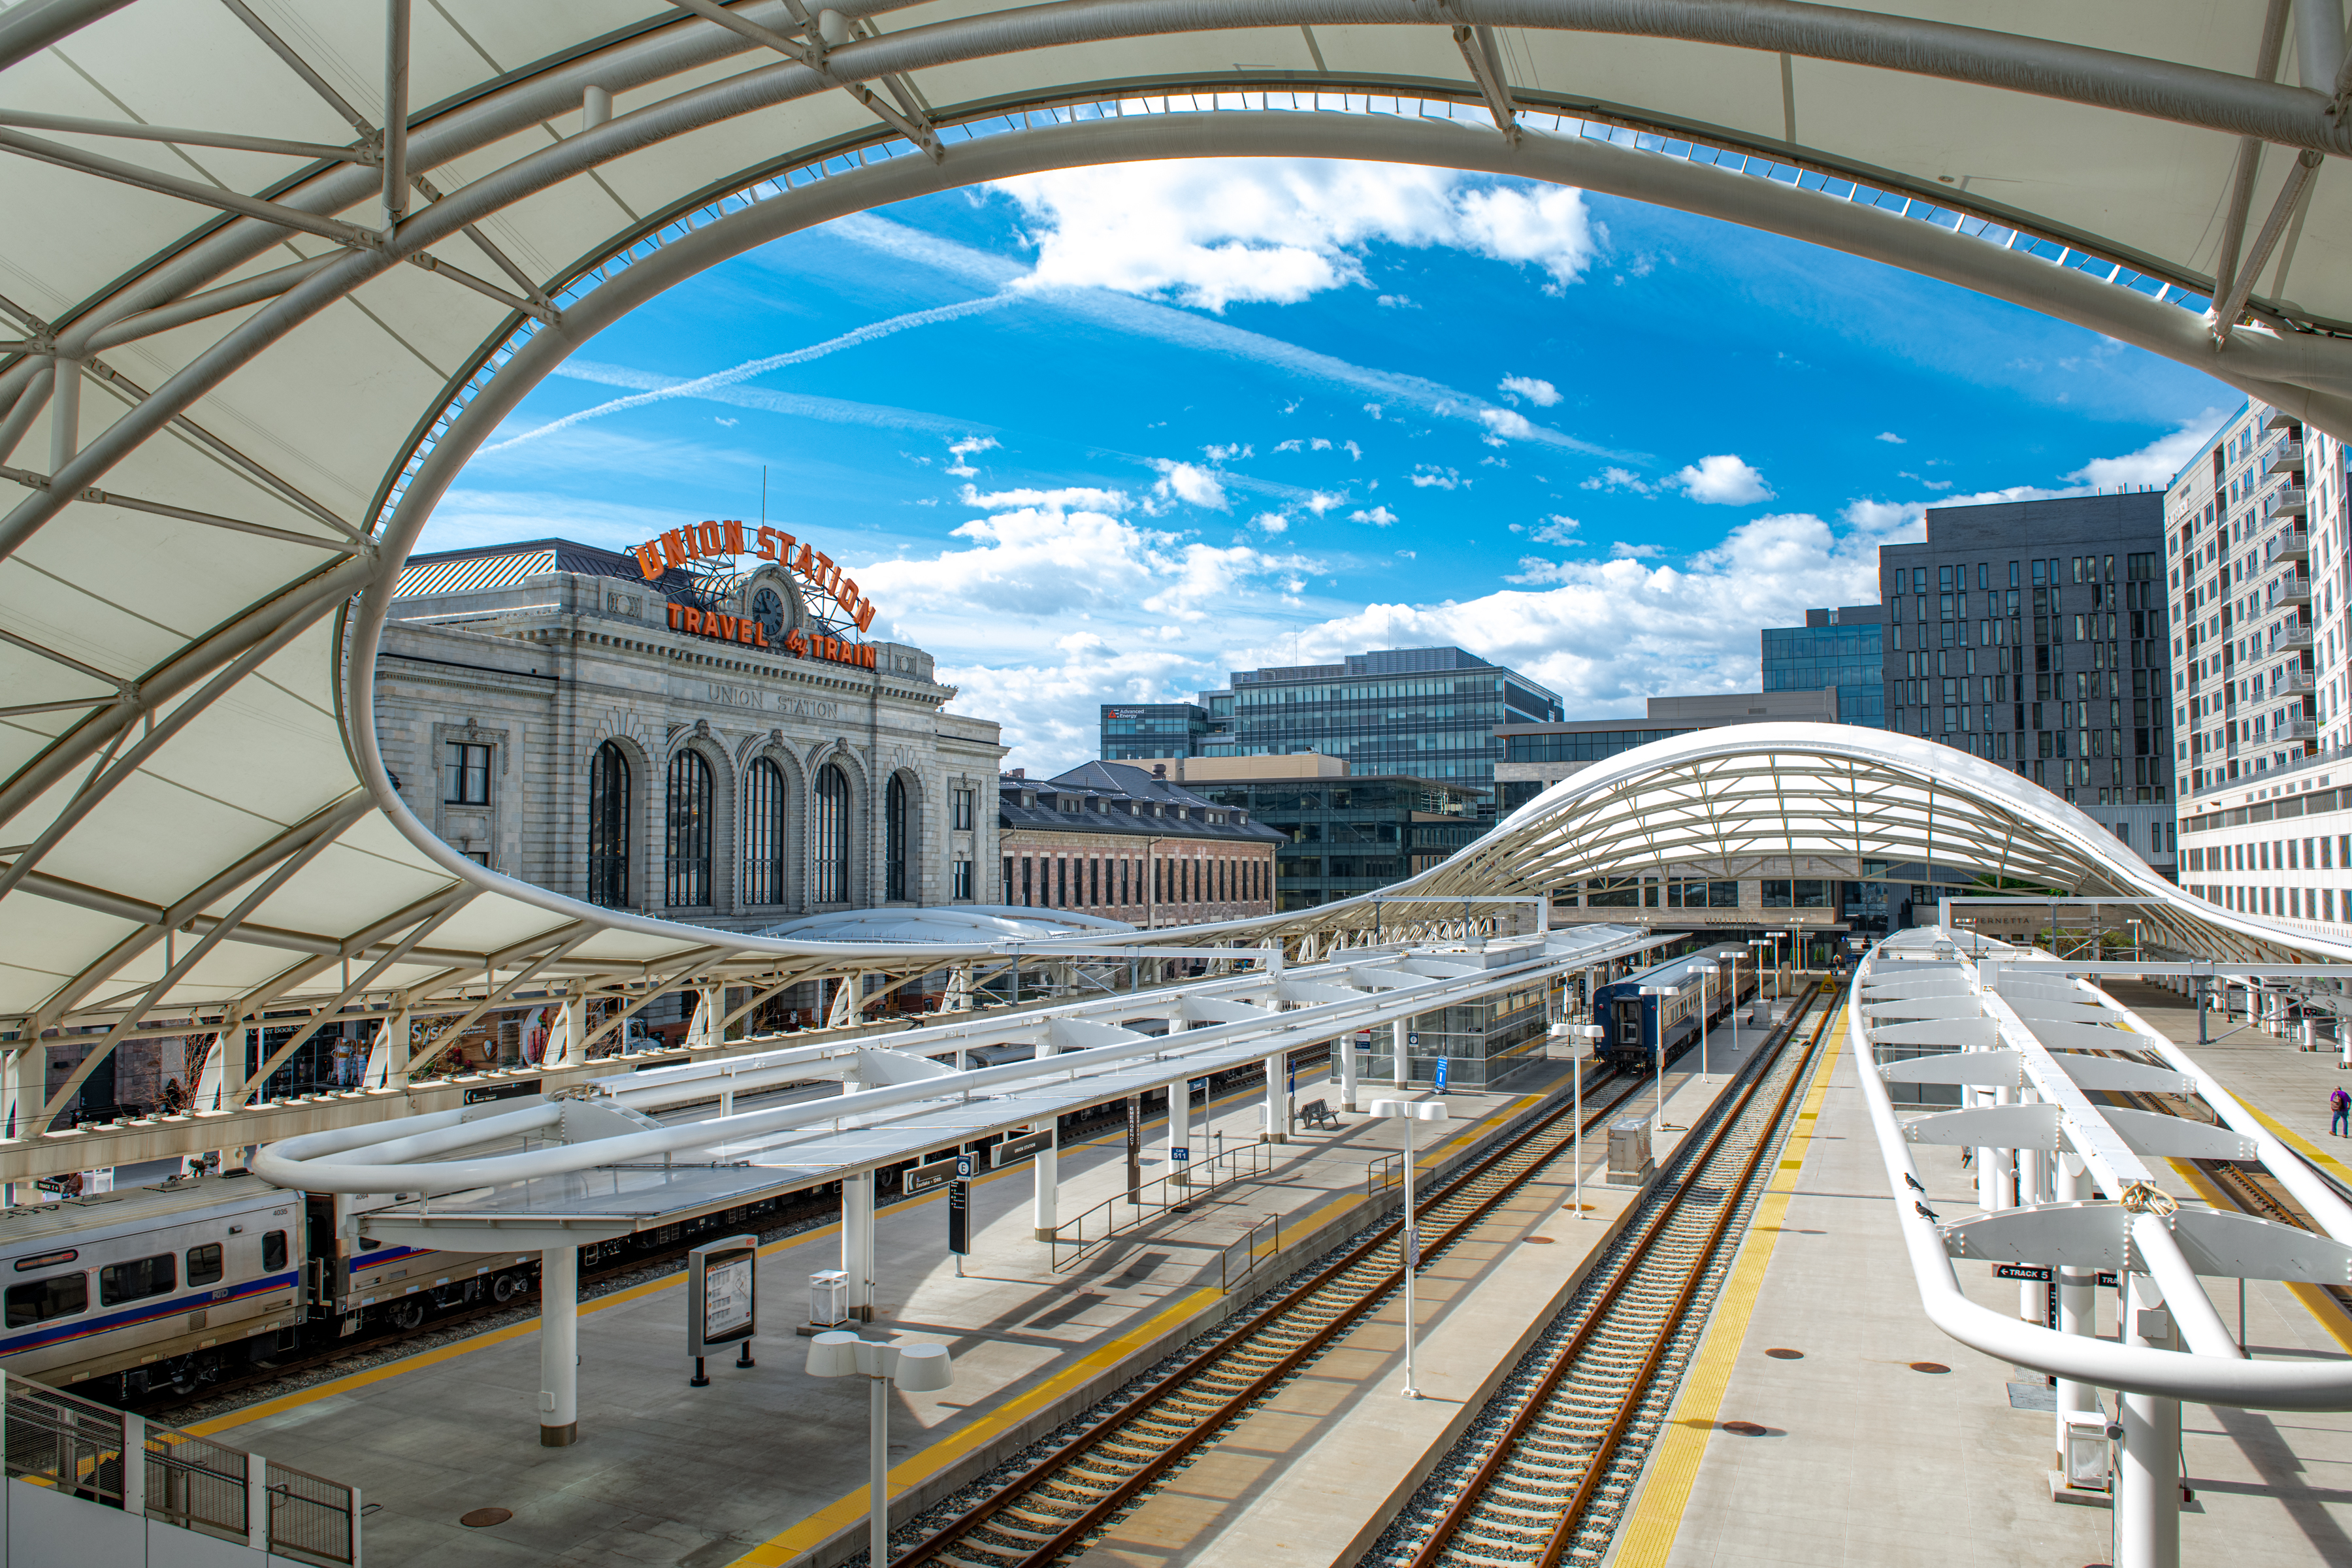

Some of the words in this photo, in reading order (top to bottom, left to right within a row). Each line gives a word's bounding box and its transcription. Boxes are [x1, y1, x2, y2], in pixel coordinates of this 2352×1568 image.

[635, 520, 744, 580] UNION
[757, 525, 875, 633] STATION
[668, 602, 769, 647] TRAVEL
[785, 629, 809, 659] by
[809, 634, 876, 668] TRAIN
[708, 684, 764, 710] UNION
[777, 695, 838, 720] STATION
[746, 1237, 755, 1246] RTD
[2009, 1269, 2038, 1278] TRACK
[2040, 1271, 2048, 1279] 5
[212, 1288, 229, 1300] RTD
